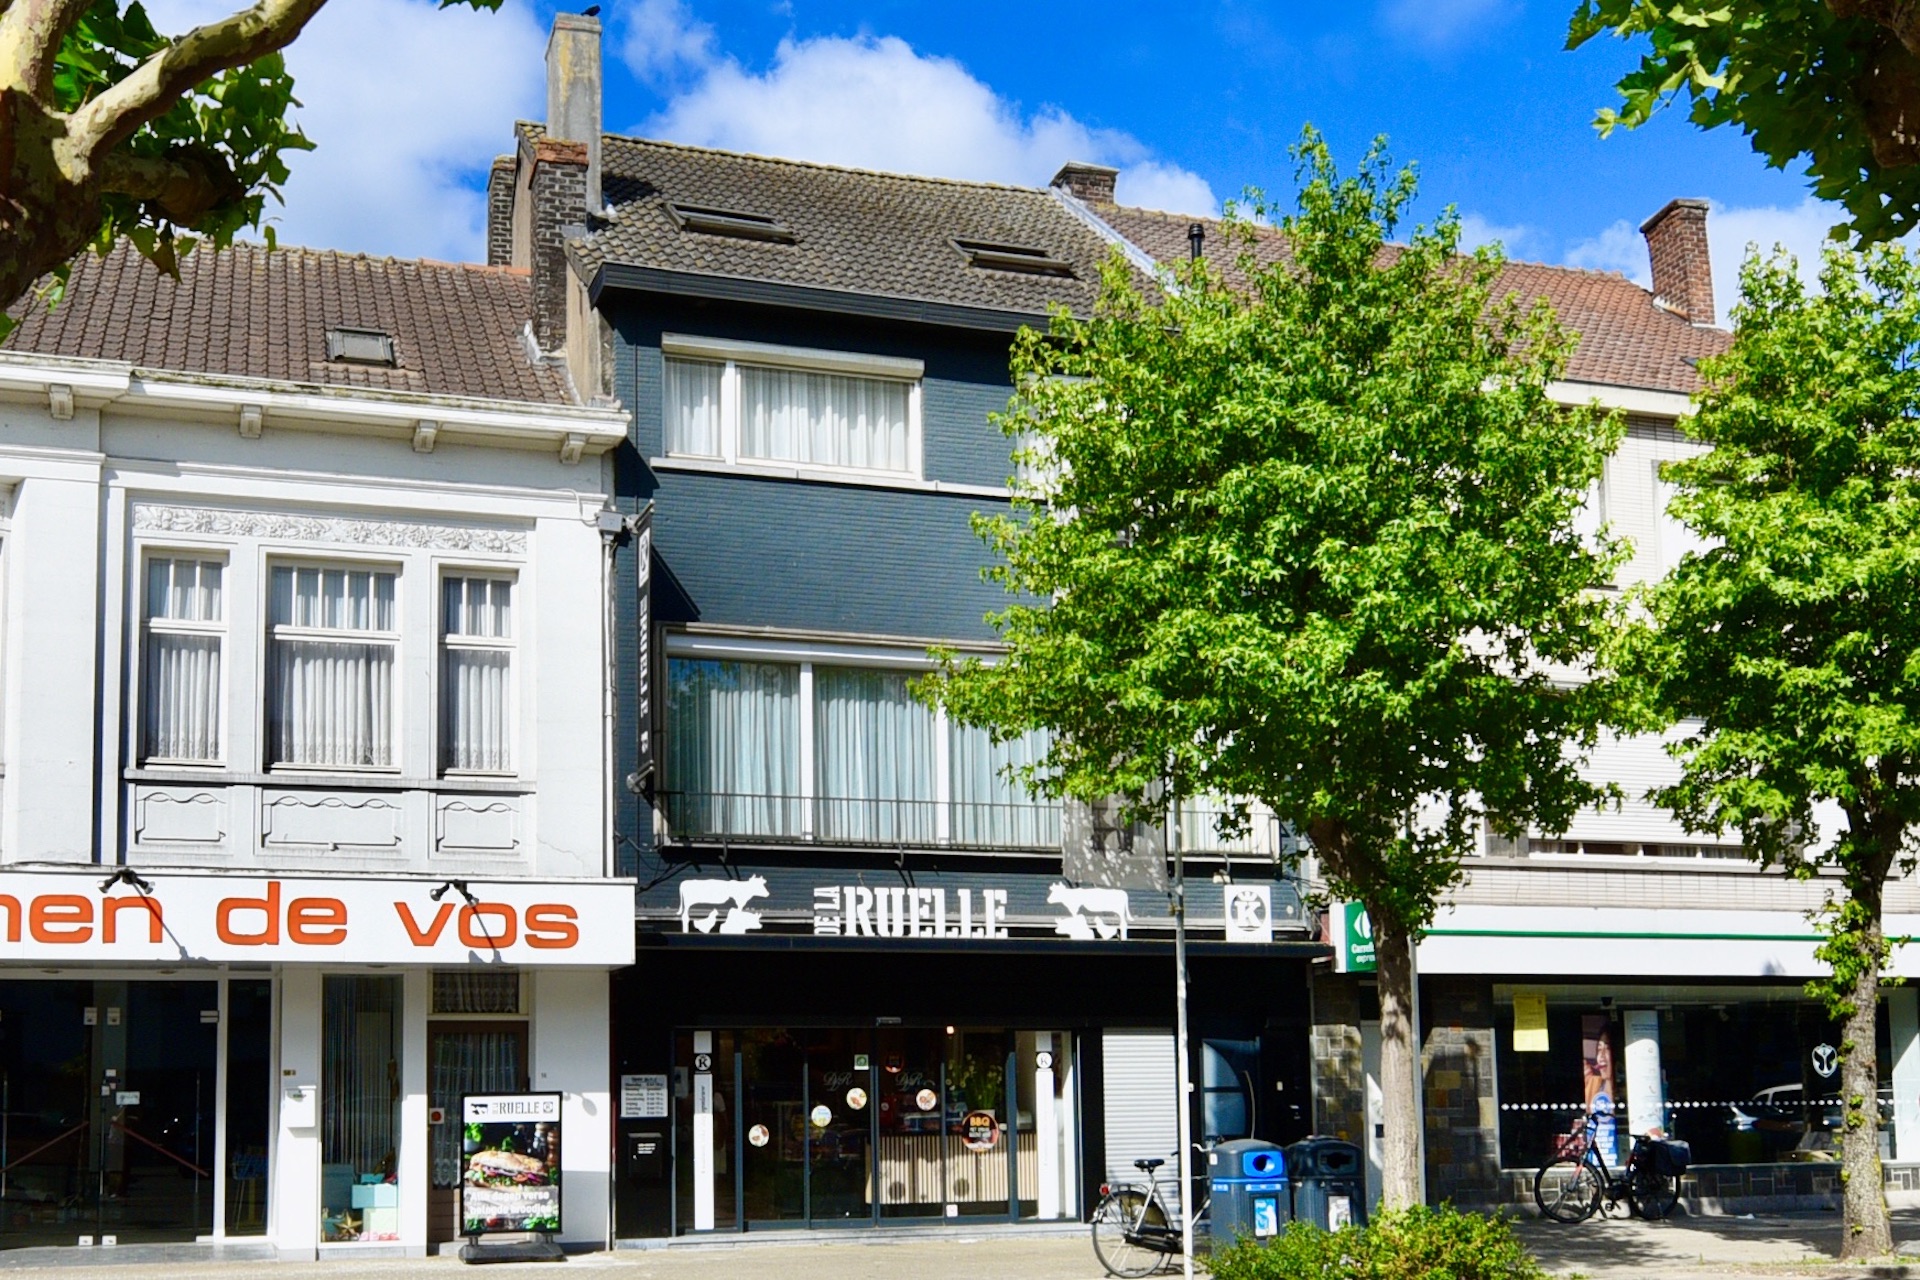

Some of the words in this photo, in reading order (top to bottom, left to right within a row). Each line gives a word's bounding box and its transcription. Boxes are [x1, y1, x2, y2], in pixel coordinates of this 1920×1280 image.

[814, 886, 840, 911] LA
[216, 881, 348, 945] de
[394, 902, 579, 949] vos
[843, 886, 1008, 939] RUELLE
[814, 916, 841, 936] DE
[499, 1102, 540, 1115] RUELLE
[523, 1191, 550, 1200] verse
